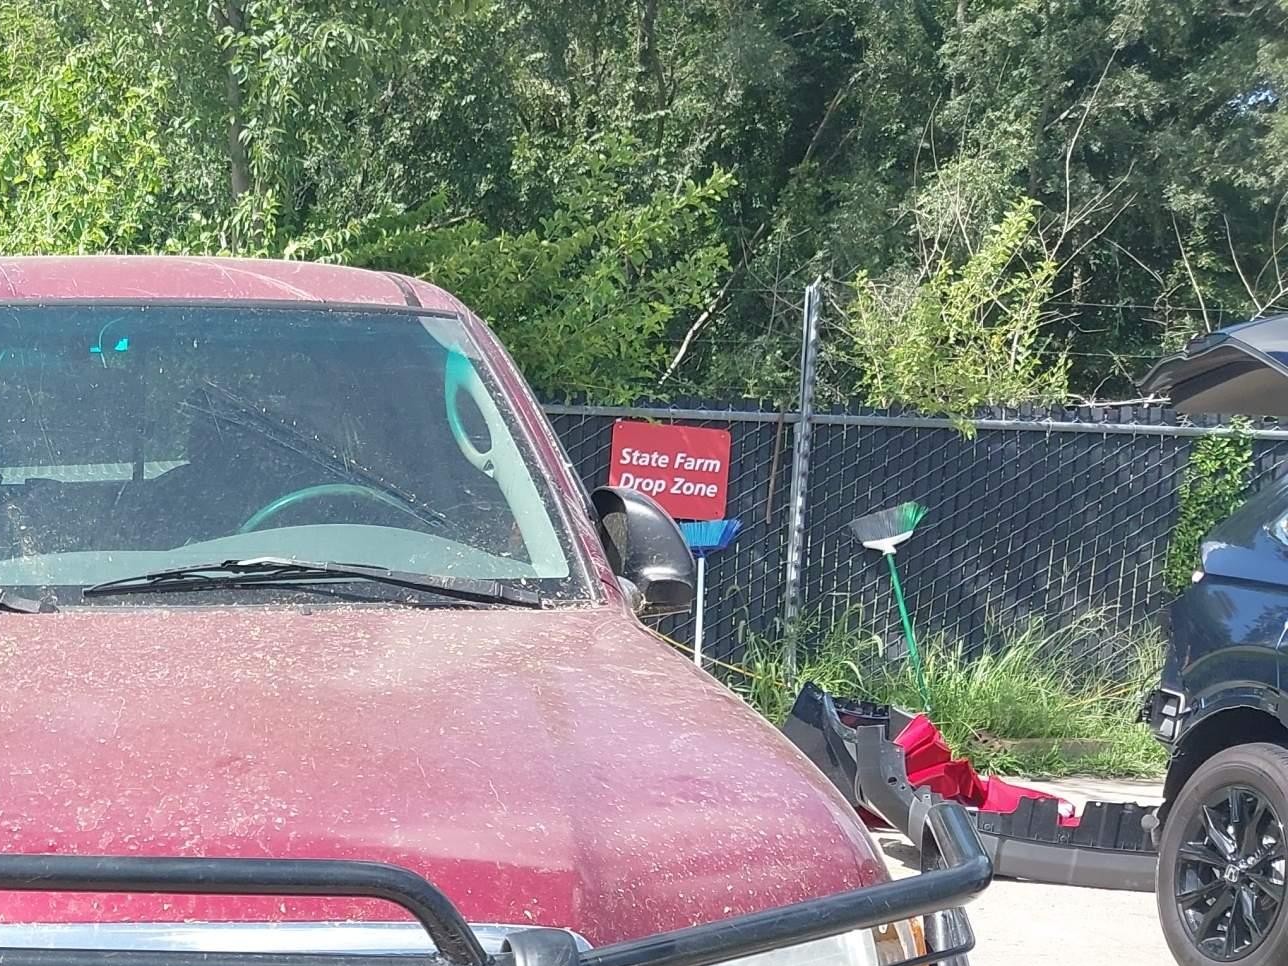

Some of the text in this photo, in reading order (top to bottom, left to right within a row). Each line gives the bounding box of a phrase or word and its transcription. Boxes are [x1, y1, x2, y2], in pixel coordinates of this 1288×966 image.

[619, 447, 721, 473] State Farm
[619, 472, 718, 497] Drop Zone
